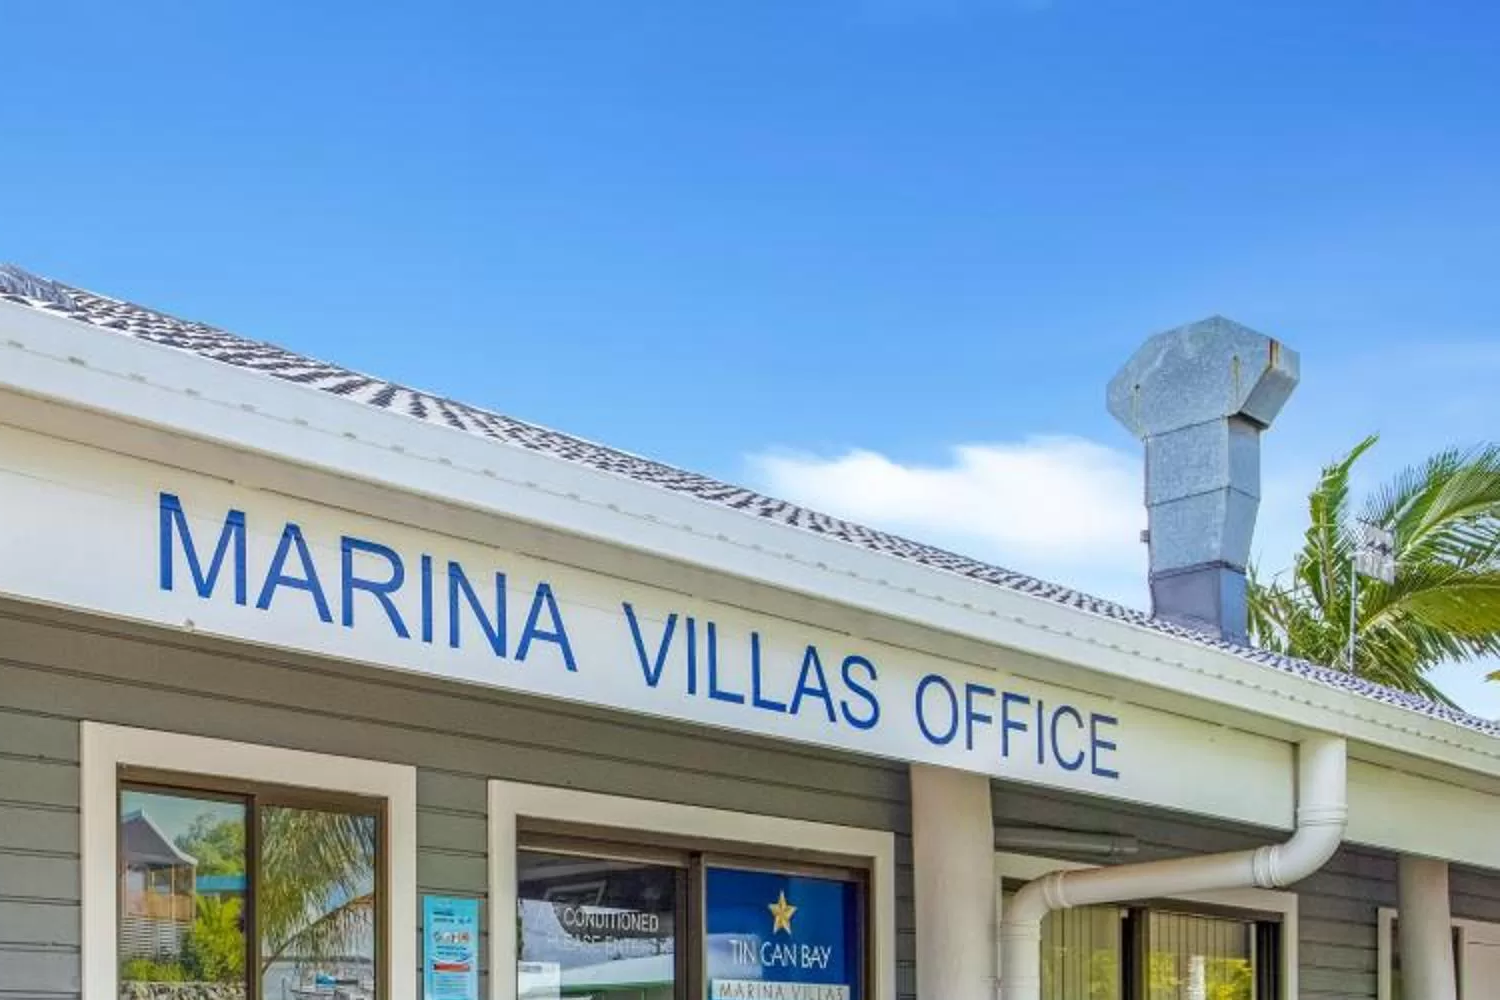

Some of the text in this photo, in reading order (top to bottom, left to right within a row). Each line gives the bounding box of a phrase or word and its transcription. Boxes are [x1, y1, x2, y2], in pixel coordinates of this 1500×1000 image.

[159, 491, 1120, 779] MARINA VILLAS OFFICE
[563, 906, 659, 933] CONDITIONED
[728, 939, 832, 969] TIN CAN BAY
[719, 982, 785, 1000] MARINA
